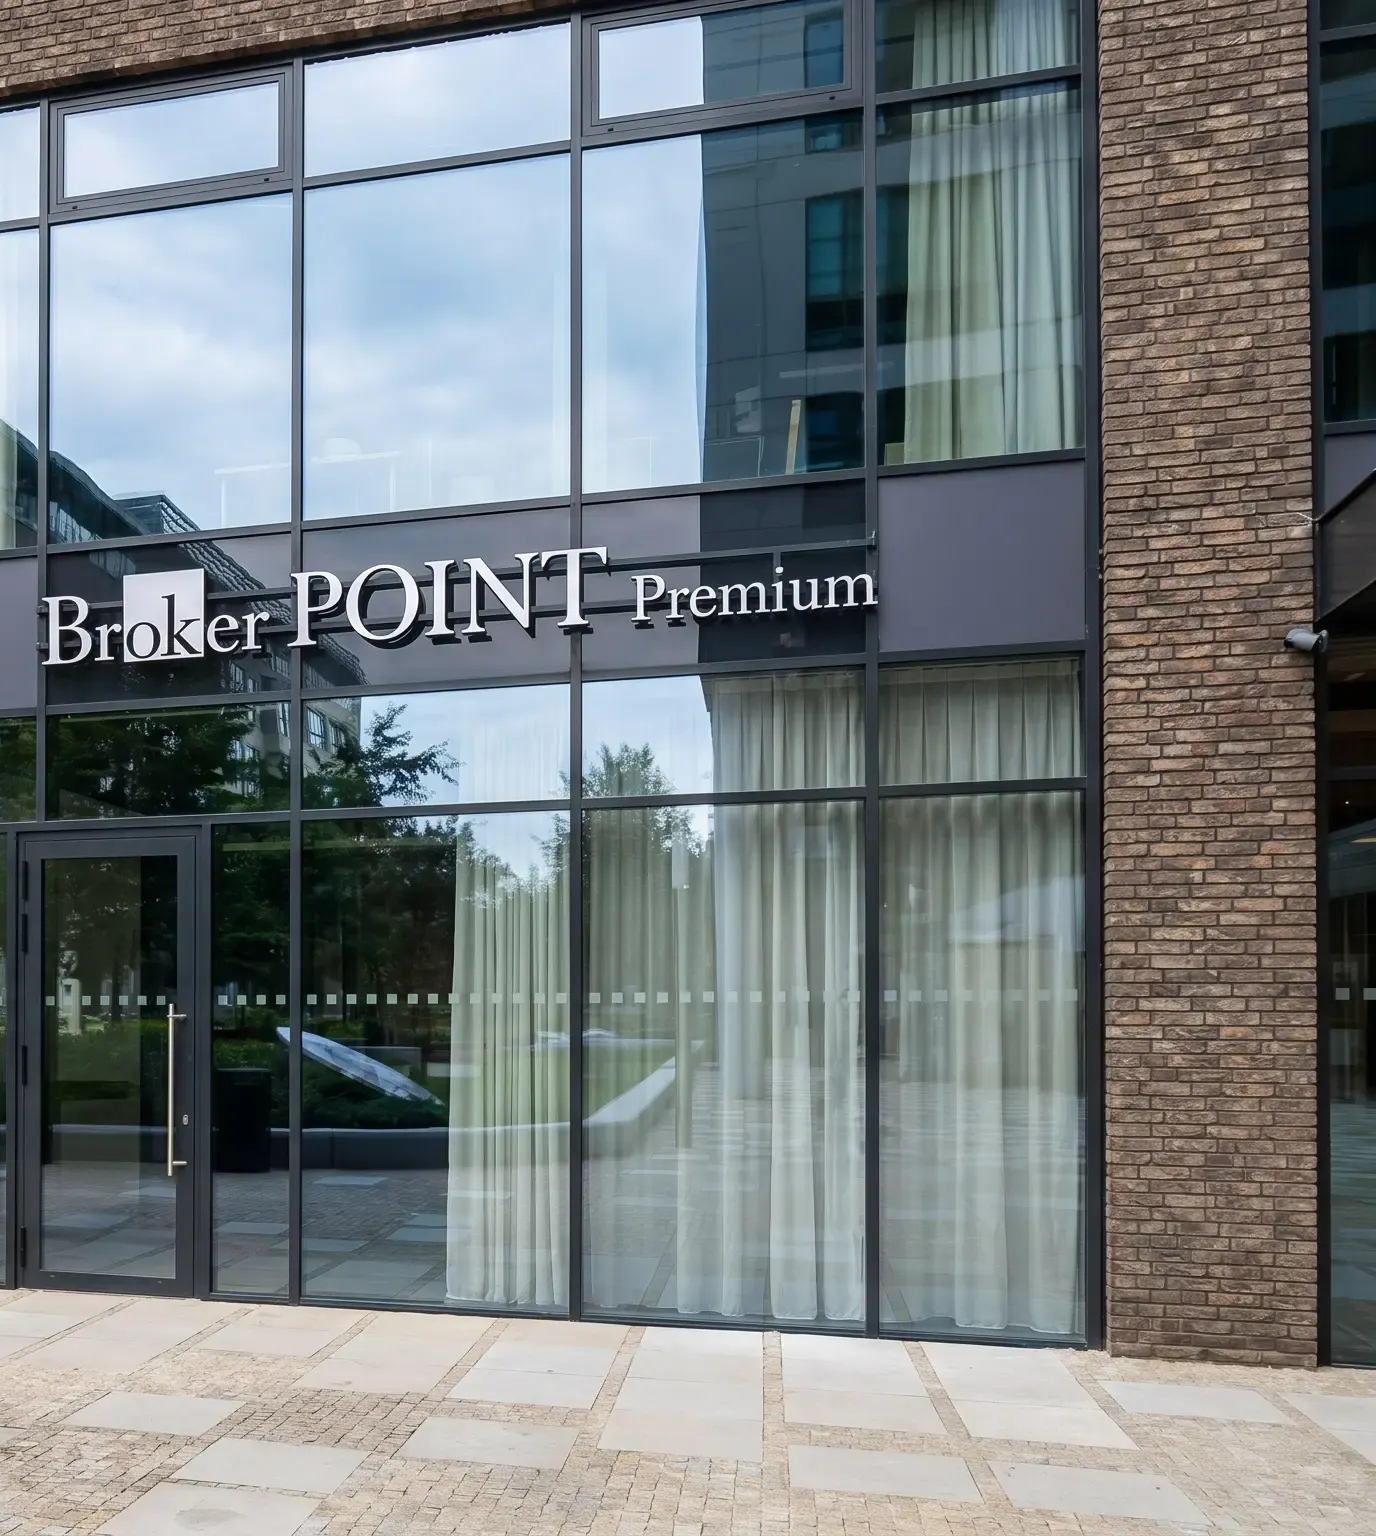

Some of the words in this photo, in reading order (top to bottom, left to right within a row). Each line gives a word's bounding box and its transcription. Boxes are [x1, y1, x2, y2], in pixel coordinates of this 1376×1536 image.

[41, 593, 270, 665] Broker
[287, 546, 608, 647] POINT
[631, 566, 879, 622] Premium
